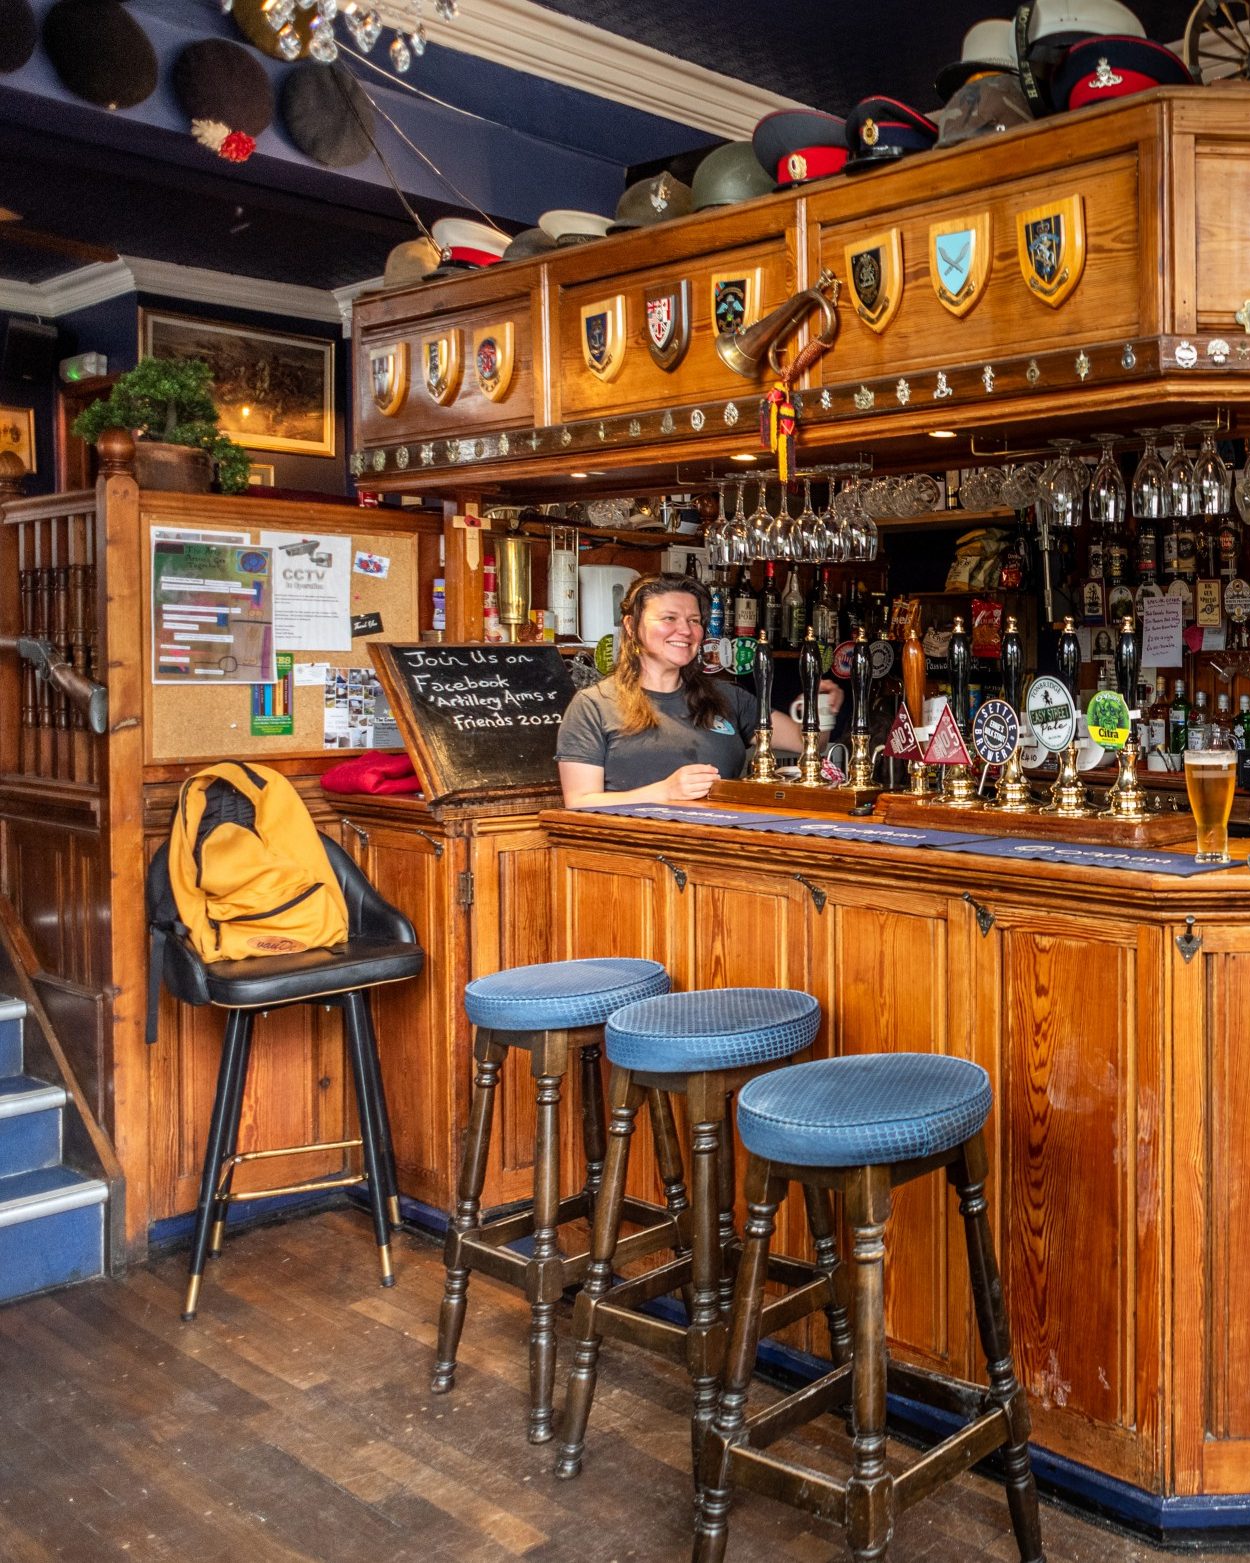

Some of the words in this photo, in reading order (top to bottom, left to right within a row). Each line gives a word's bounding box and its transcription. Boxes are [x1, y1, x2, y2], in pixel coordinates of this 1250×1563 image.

[282, 568, 326, 581] CCTV
[403, 651, 469, 668] Join
[470, 650, 499, 664] Us
[505, 655, 534, 664] on
[411, 674, 510, 693] Facebook
[1030, 681, 1062, 699] TONBRIDGE
[504, 689, 544, 709] Arms
[453, 712, 513, 731] Friends
[516, 713, 564, 726] 2022
[982, 702, 1017, 731] SETTLE
[1030, 708, 1048, 724] EASY
[1048, 704, 1071, 721] STREET
[1041, 719, 1068, 736] Pale
[1098, 728, 1119, 739] Citra
[975, 728, 1013, 762] BREWERY
